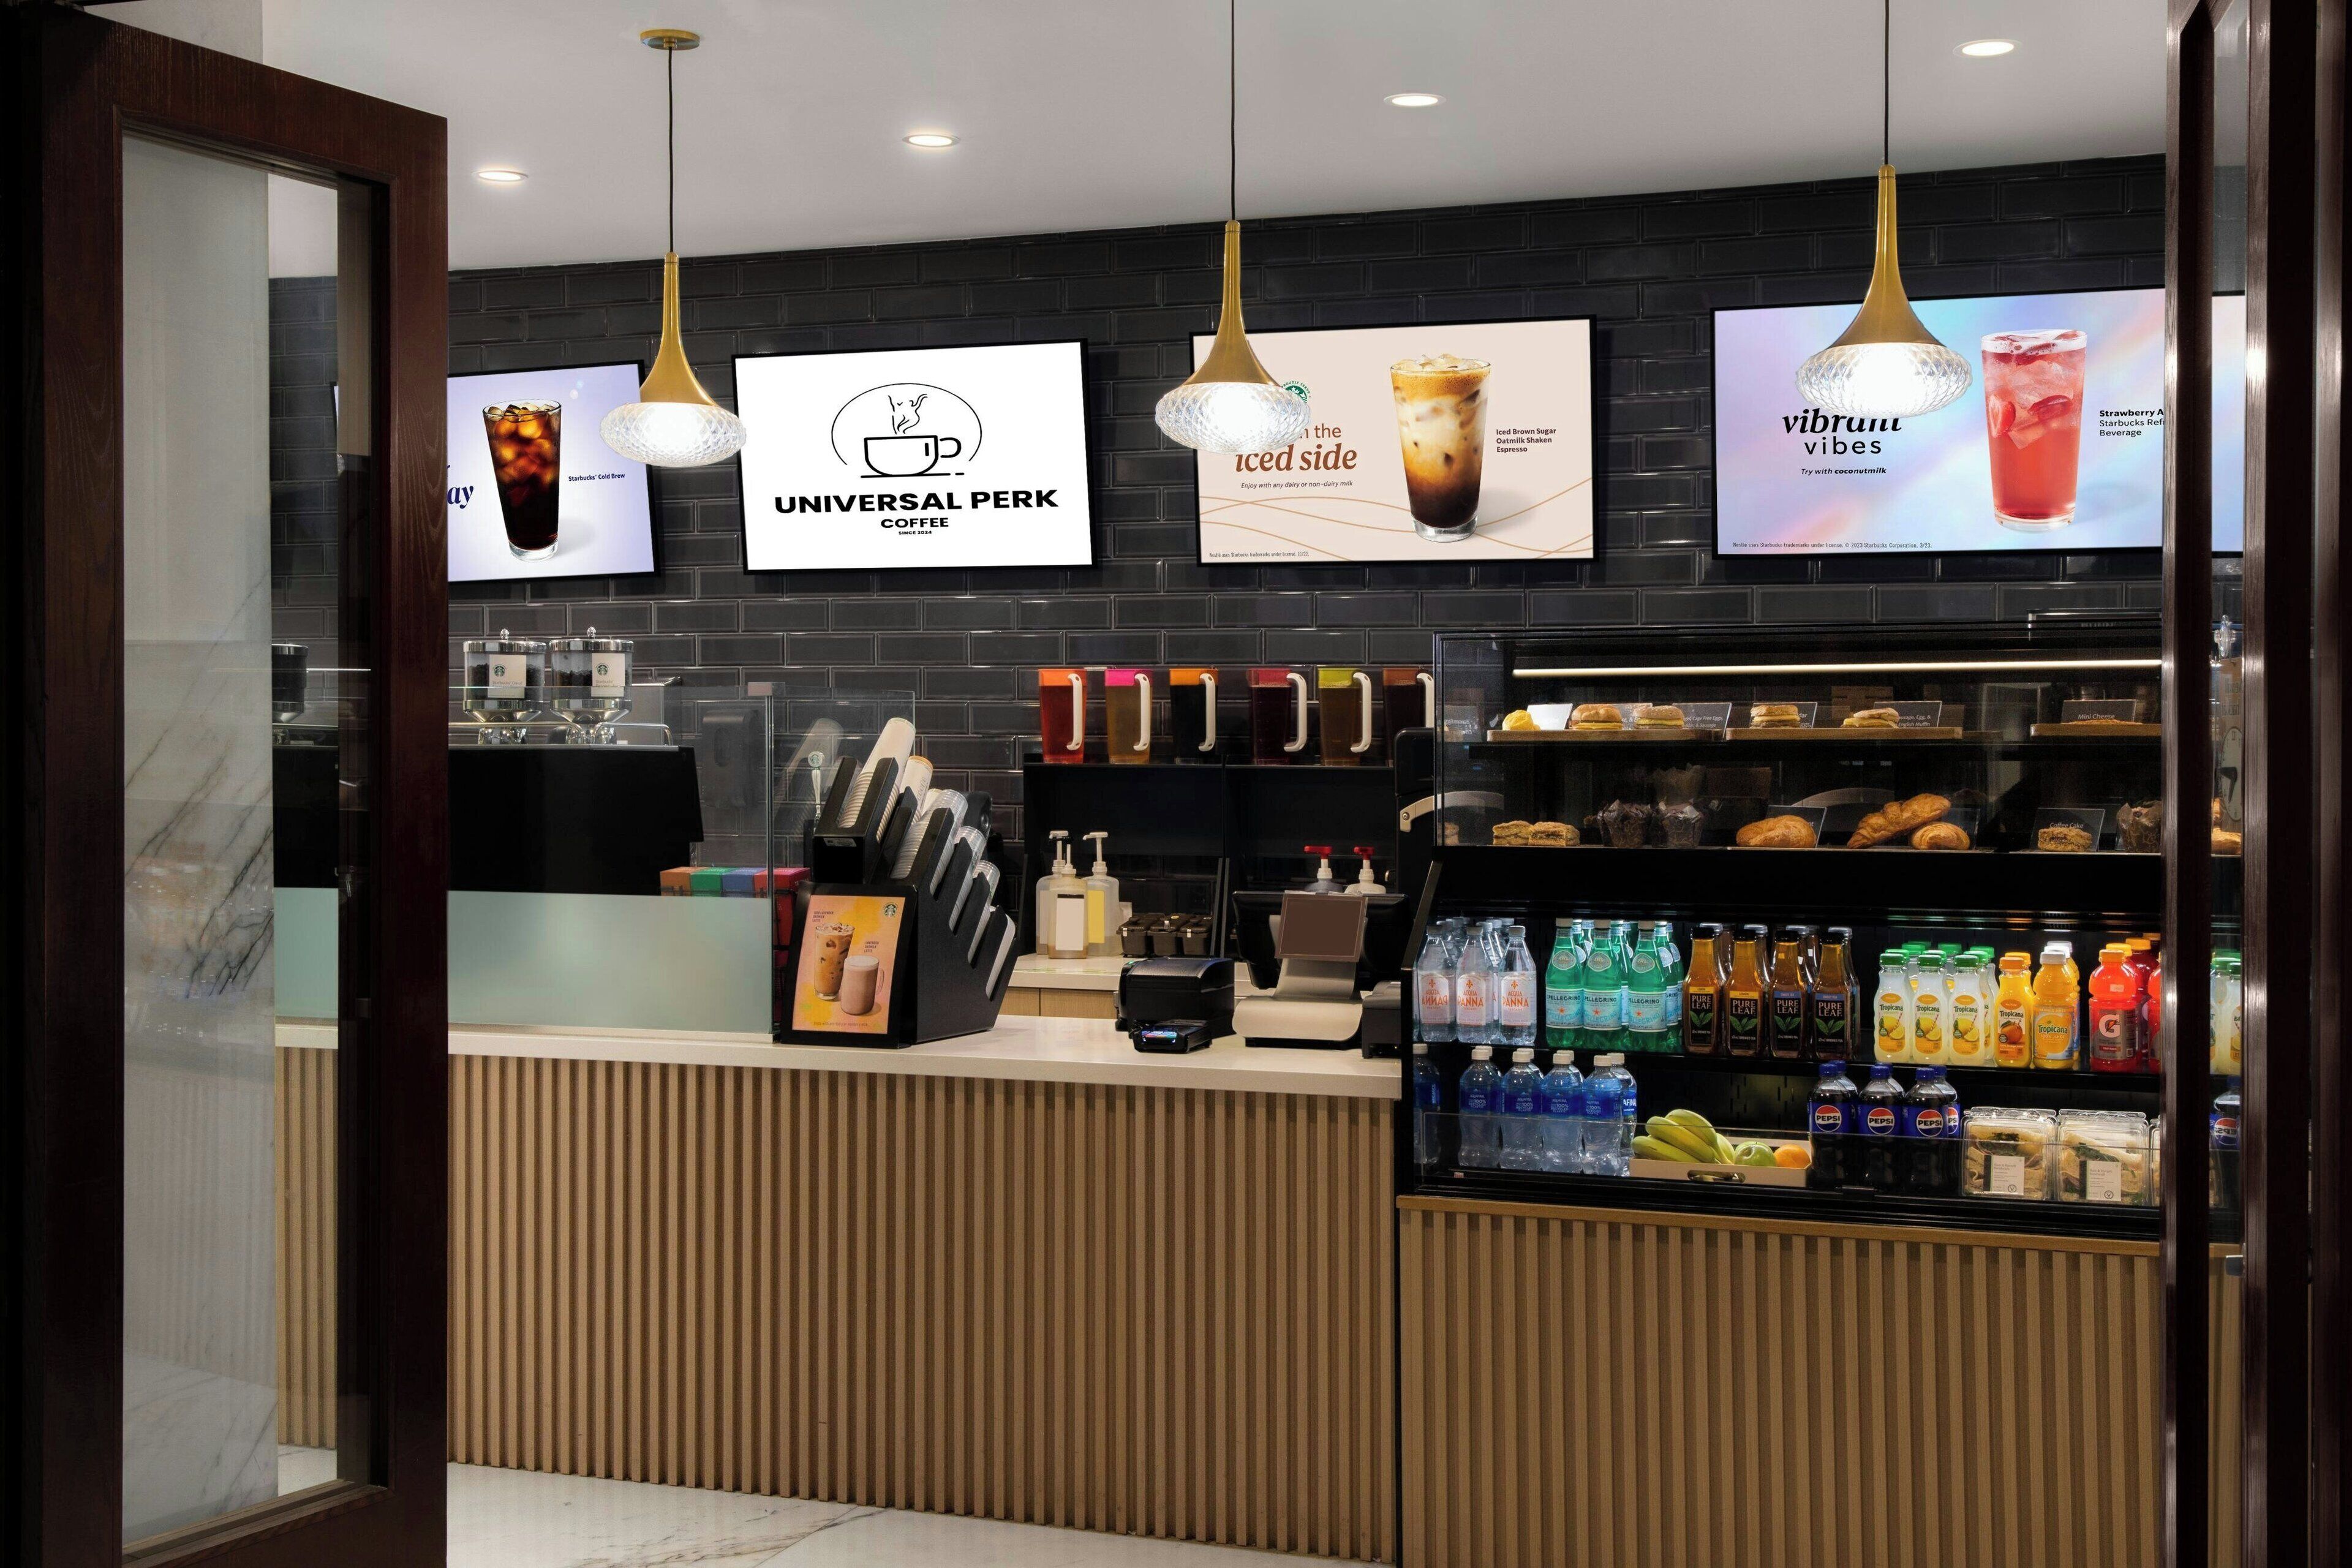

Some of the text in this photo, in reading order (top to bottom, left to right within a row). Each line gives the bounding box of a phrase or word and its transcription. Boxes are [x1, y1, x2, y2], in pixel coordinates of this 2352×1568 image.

[1314, 423, 1341, 438] the
[1804, 436, 1882, 454] vibes
[1235, 443, 1357, 472] iced side
[775, 489, 1059, 513] UNIVERSAL PERK
[880, 518, 949, 528] COFFEE
[1458, 995, 1484, 1007] PANNA
[1502, 996, 1529, 1008] PANNA
[2038, 1025, 2068, 1033] Tropicana
[2099, 1014, 2120, 1038] G
[1623, 1098, 1637, 1107] AFINA
